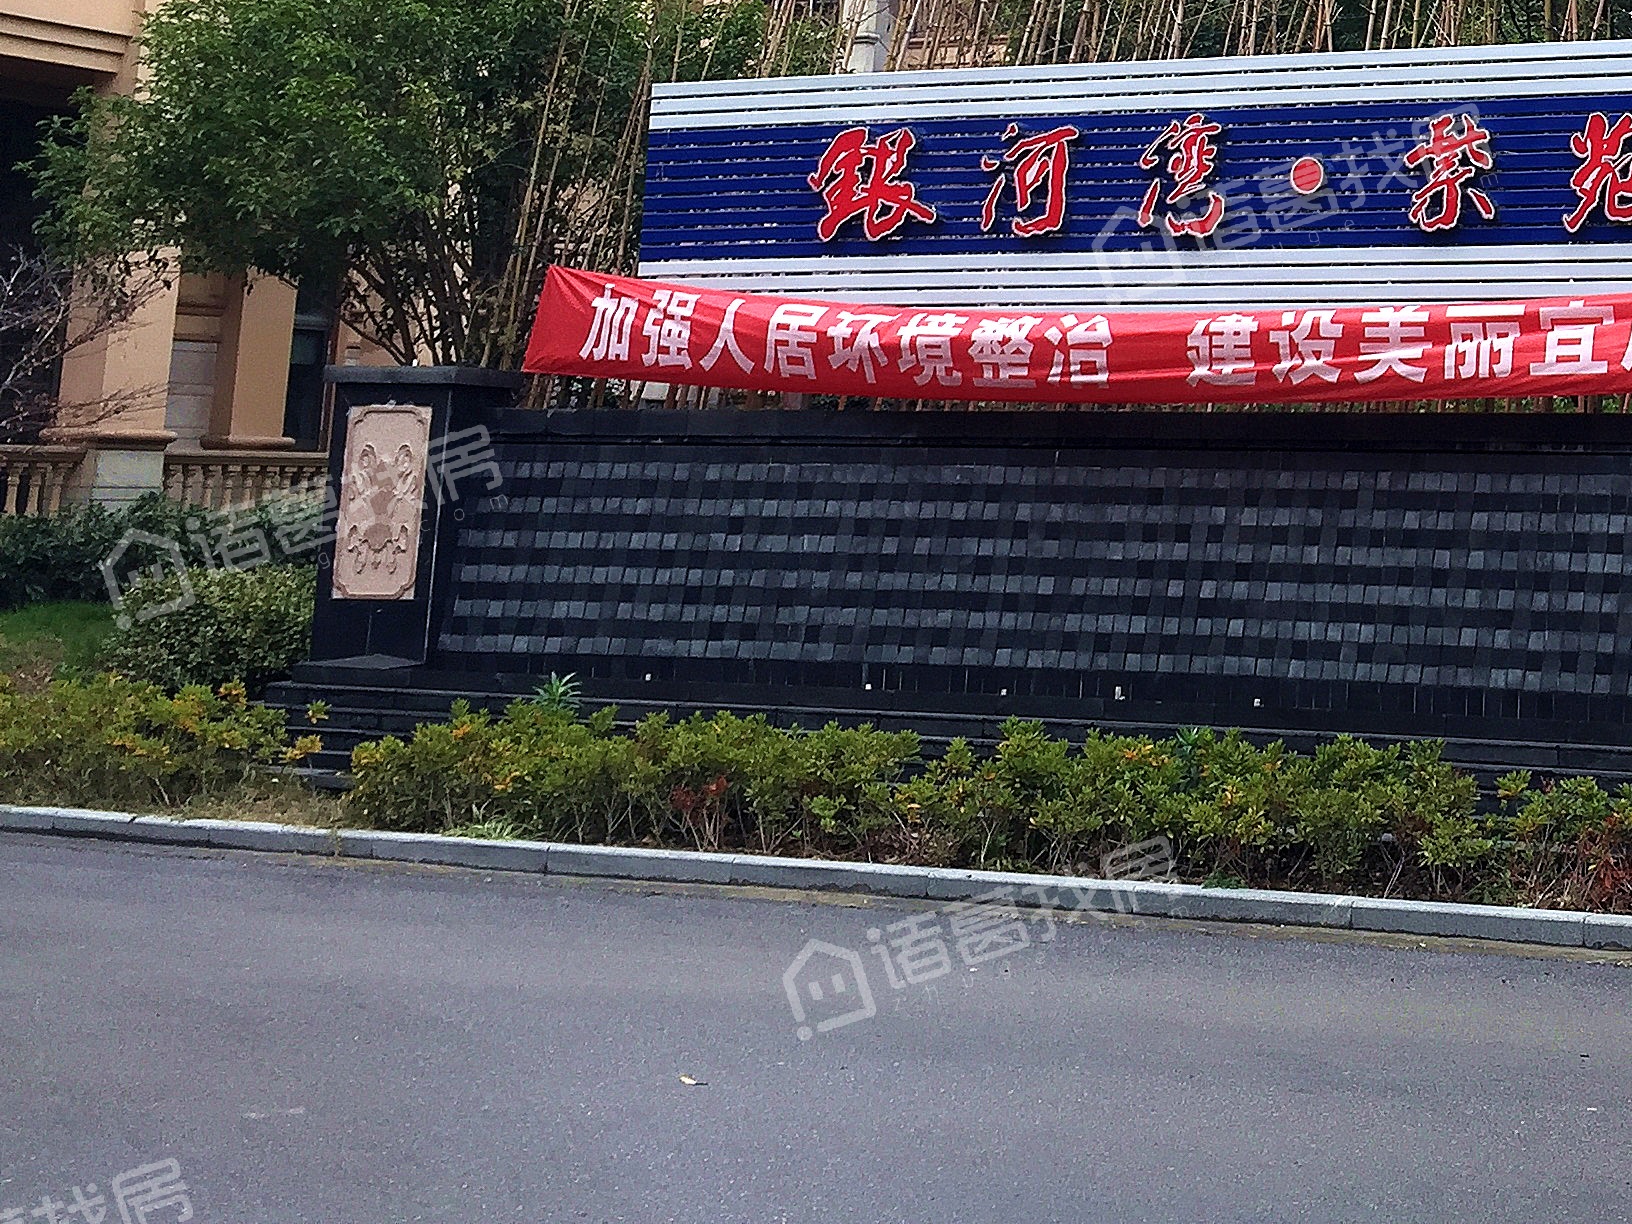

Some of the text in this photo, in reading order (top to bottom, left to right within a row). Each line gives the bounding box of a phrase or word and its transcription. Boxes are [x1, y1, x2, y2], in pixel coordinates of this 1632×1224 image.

[579, 283, 1114, 389] 加强人居环境整治
